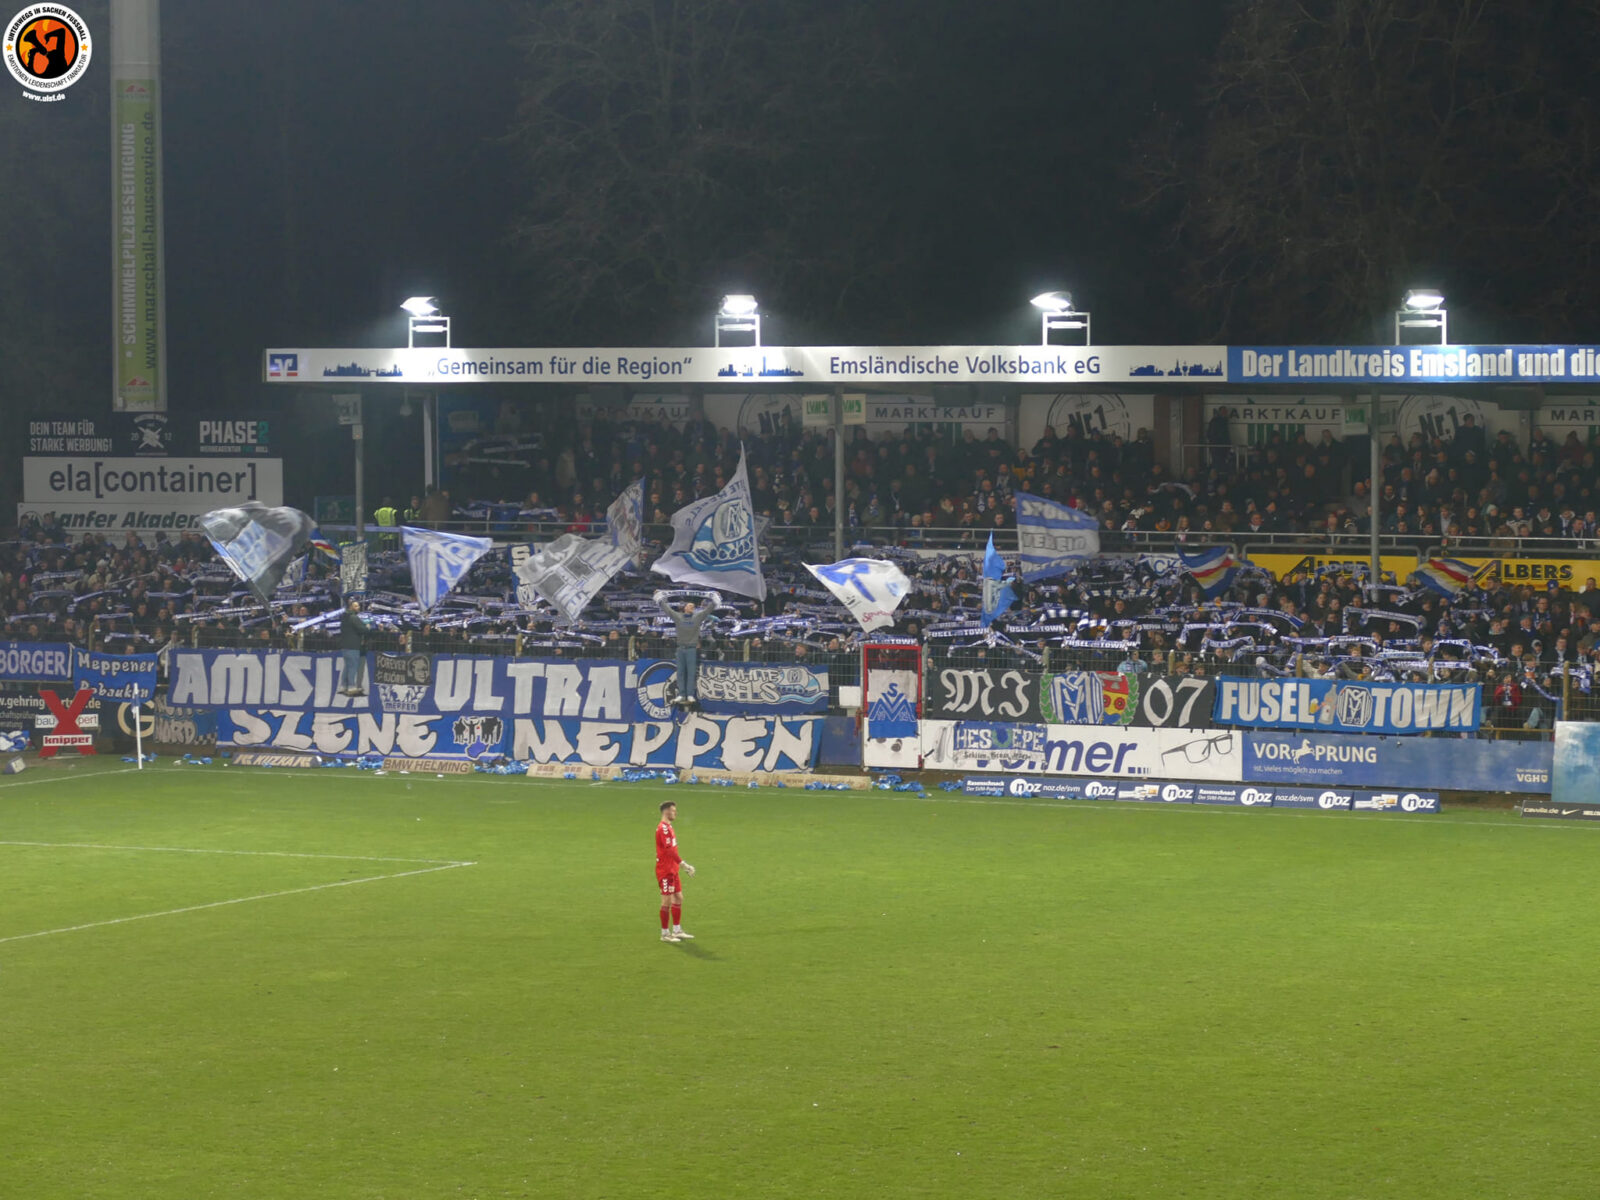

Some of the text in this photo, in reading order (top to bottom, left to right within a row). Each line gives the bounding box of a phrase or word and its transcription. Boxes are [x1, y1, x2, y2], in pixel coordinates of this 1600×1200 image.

[122, 122, 136, 345] SCHIMMELPILZBESEITIGUNG
[143, 111, 155, 370] www.marschall-hausservice.de
[549, 356, 577, 375] für
[582, 356, 611, 375] die
[830, 355, 1100, 374] Emsländische Volksbank eG
[1242, 349, 1283, 377] Der
[1288, 349, 1404, 377] Landkreis
[1410, 349, 1512, 377] Emsland
[1518, 349, 1565, 377] und
[875, 407, 995, 419] MARKTKAUF
[30, 419, 95, 435] DEIN TEAM FÜR
[200, 421, 270, 443] PHASE2
[30, 438, 113, 451] STARKE WERBUNG!
[1474, 559, 1573, 580] ALBERS
[0, 643, 67, 676] BÖRGER
[78, 651, 154, 676] Meppener
[697, 678, 781, 704] REBELS
[1221, 681, 1476, 728] FUSEL TOWN
[36, 715, 56, 726] bau
[78, 714, 98, 726] pert
[44, 736, 91, 745] knipper
[229, 708, 813, 772] SZENE MEPPEN
[383, 760, 469, 772] BMW HELMING
[1282, 766, 1307, 775] möglich
[1318, 767, 1343, 775] machen
[1516, 774, 1540, 783] VGH
[1043, 784, 1081, 793] noz.de/svm
[1275, 794, 1314, 803] noz.de/svm
